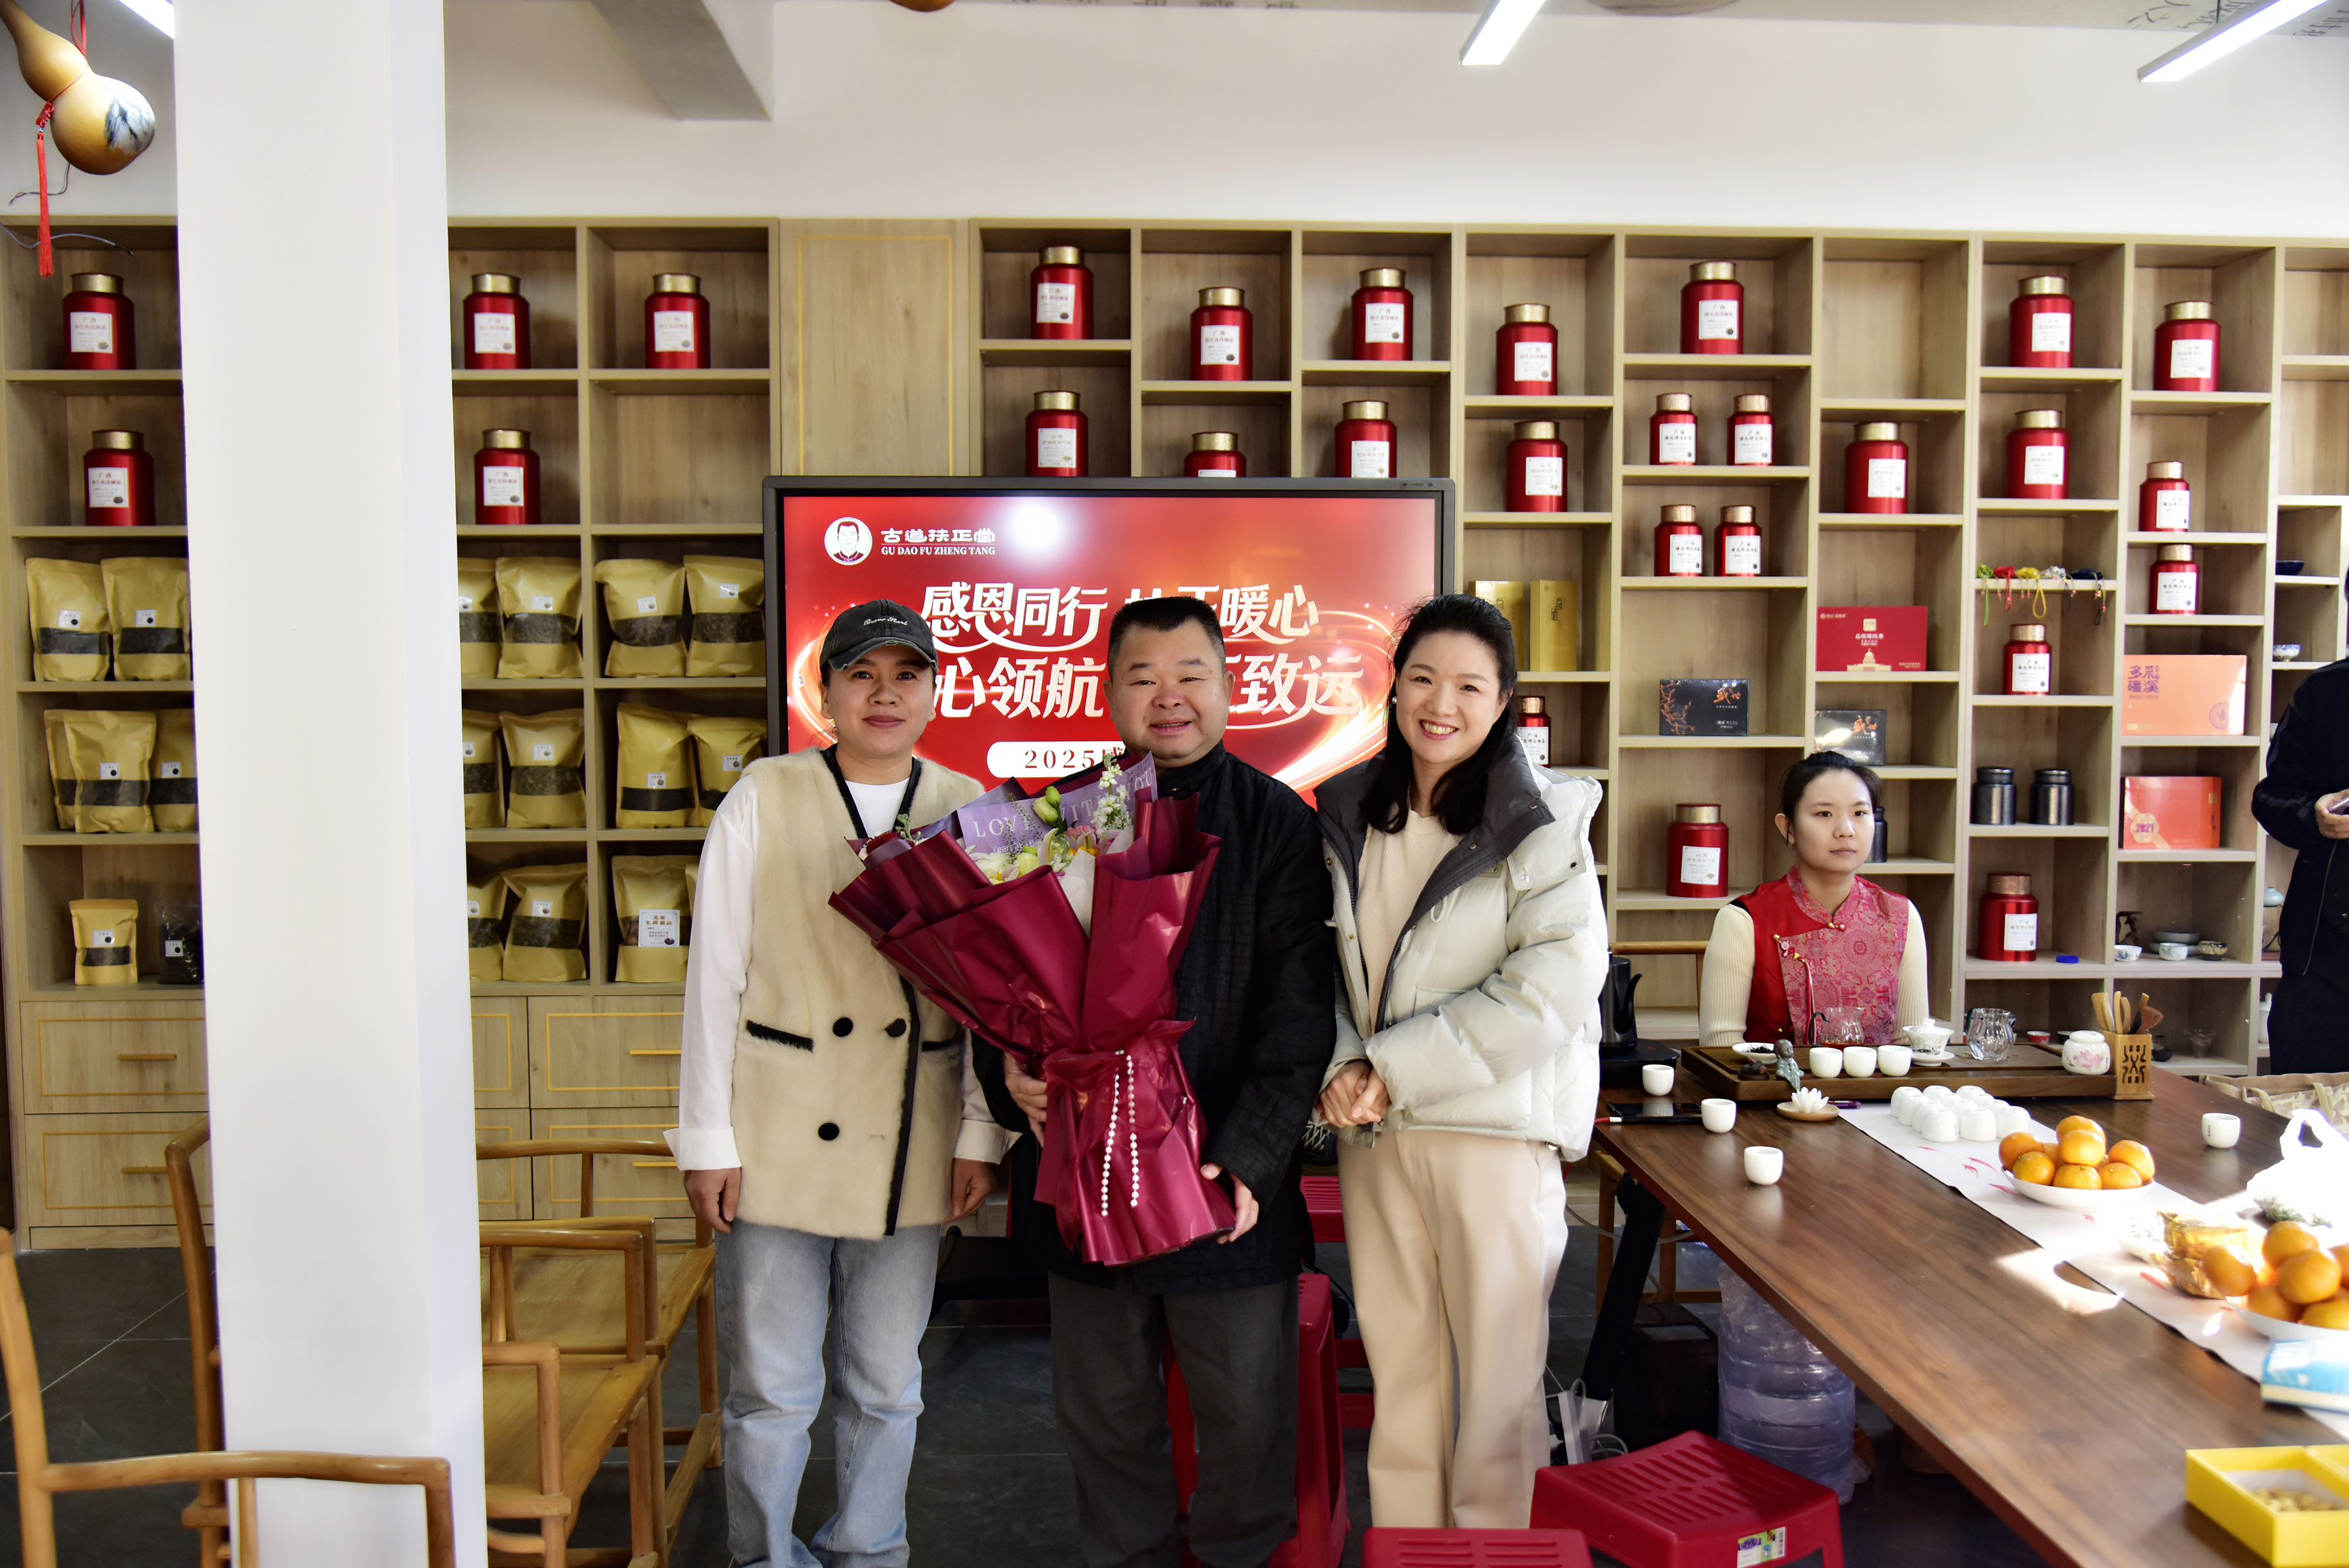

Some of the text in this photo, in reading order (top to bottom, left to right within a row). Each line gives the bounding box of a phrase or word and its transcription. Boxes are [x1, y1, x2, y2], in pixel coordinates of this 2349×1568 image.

[881, 527, 996, 544] 古道扶正堂
[920, 581, 1109, 649] 感恩同行
[2128, 665, 2160, 679] 多彩
[1225, 653, 1364, 728] 致远
[2136, 823, 2155, 833] 2021
